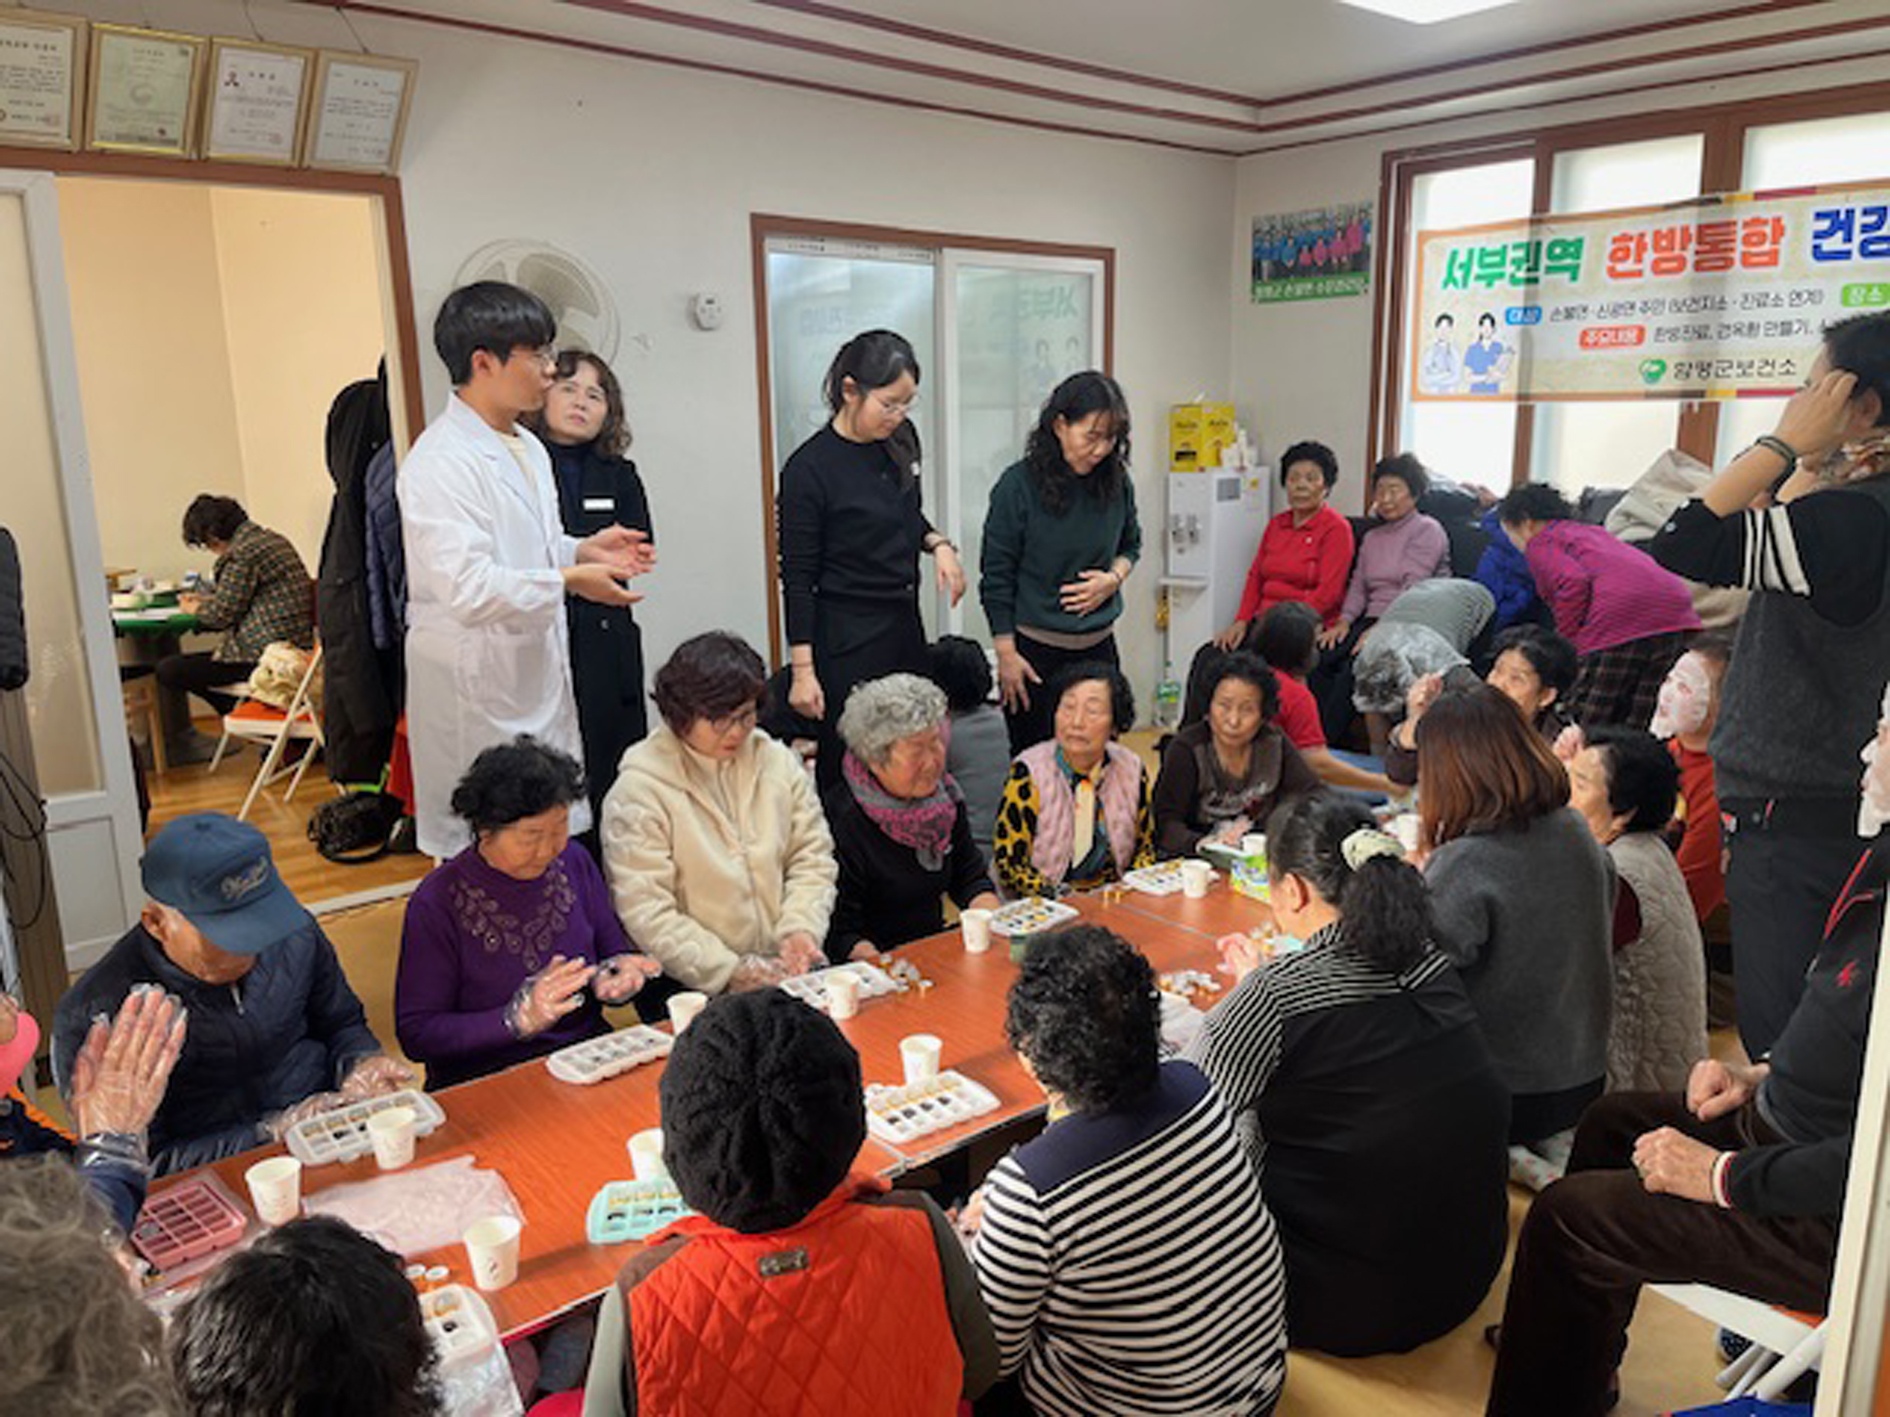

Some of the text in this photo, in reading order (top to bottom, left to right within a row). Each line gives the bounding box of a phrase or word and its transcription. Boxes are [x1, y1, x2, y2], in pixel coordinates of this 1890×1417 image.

[1441, 236, 1584, 290] 서부권역
[1606, 216, 1786, 279] 한방통합
[1673, 358, 1797, 380] 함평군보건소
